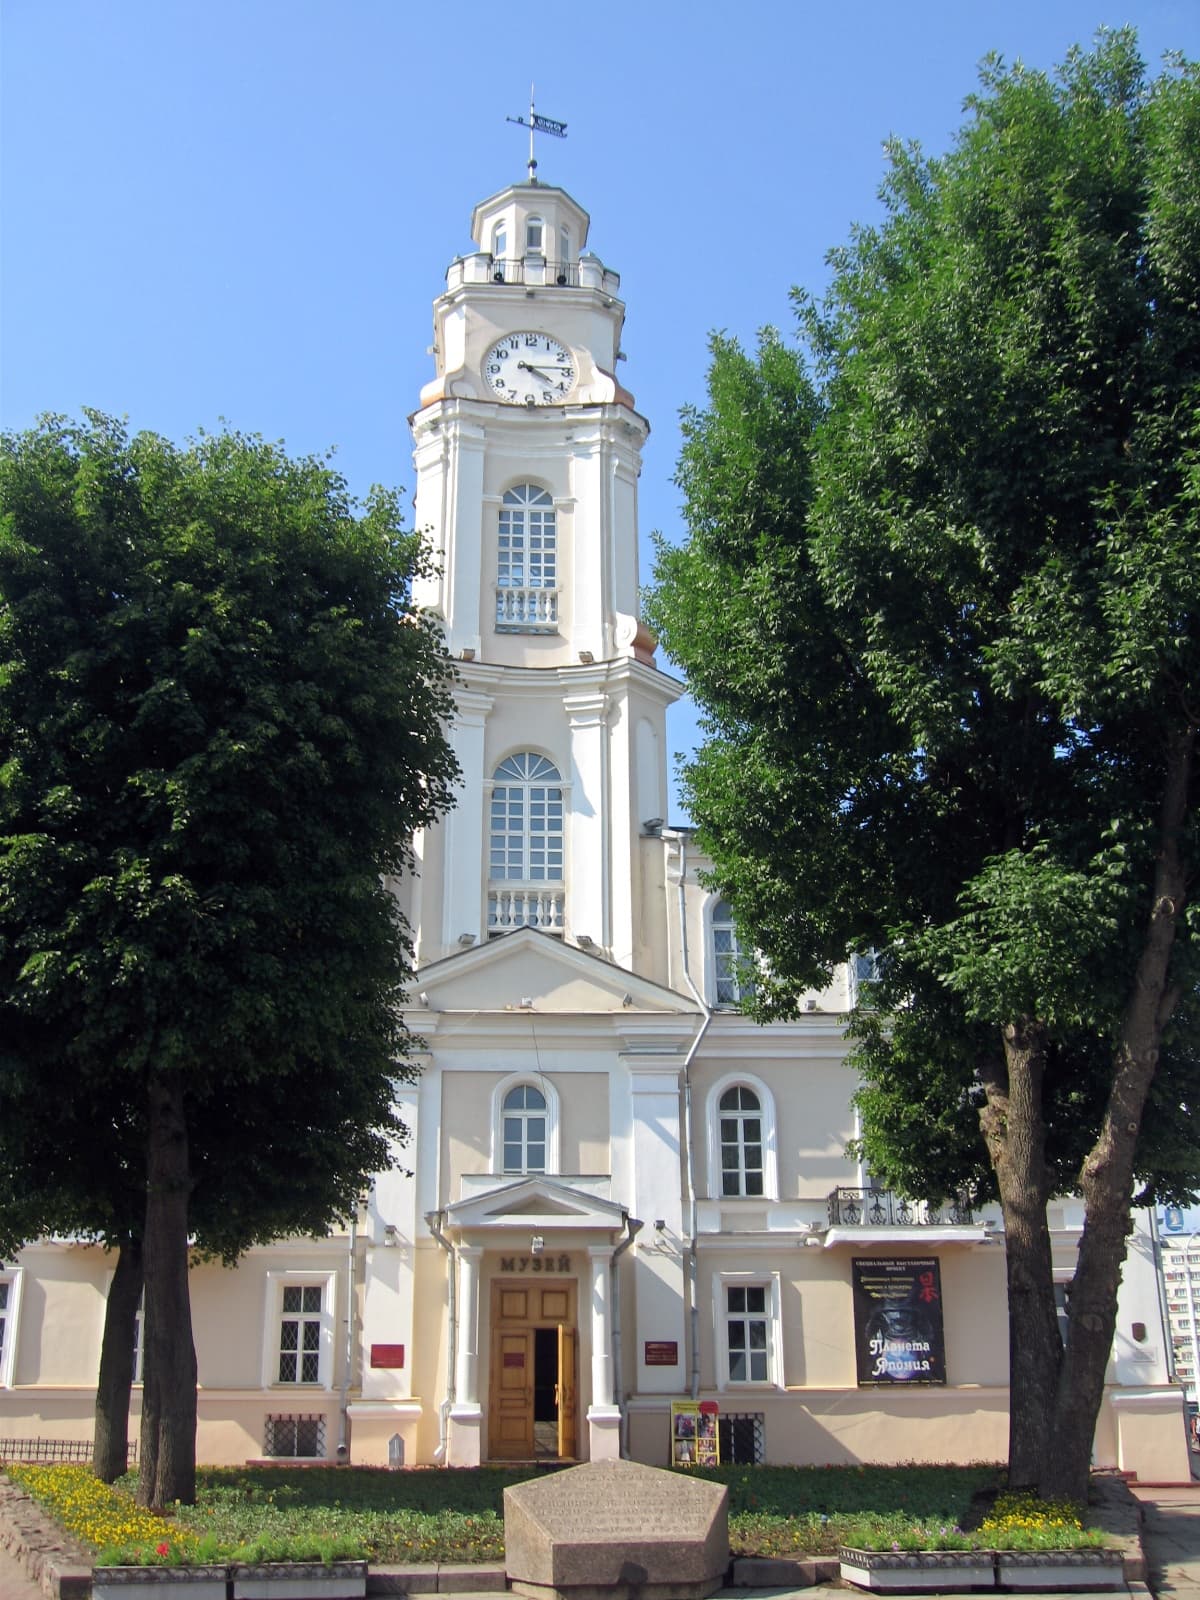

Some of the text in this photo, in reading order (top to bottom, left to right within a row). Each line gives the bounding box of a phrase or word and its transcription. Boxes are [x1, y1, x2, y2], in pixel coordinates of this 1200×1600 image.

[510, 339, 519, 349] 11
[525, 336, 538, 347] 12
[495, 347, 509, 359] 10
[556, 352, 565, 362] 2
[490, 364, 501, 374] 9
[561, 367, 571, 377] 3
[495, 378, 505, 388] 8
[555, 381, 564, 392] 4
[507, 389, 518, 399] 7
[542, 391, 553, 403] 5
[500, 1253, 571, 1273] МУЗЕЙ
[869, 1339, 930, 1356] Планета
[871, 1357, 931, 1376] Япония
